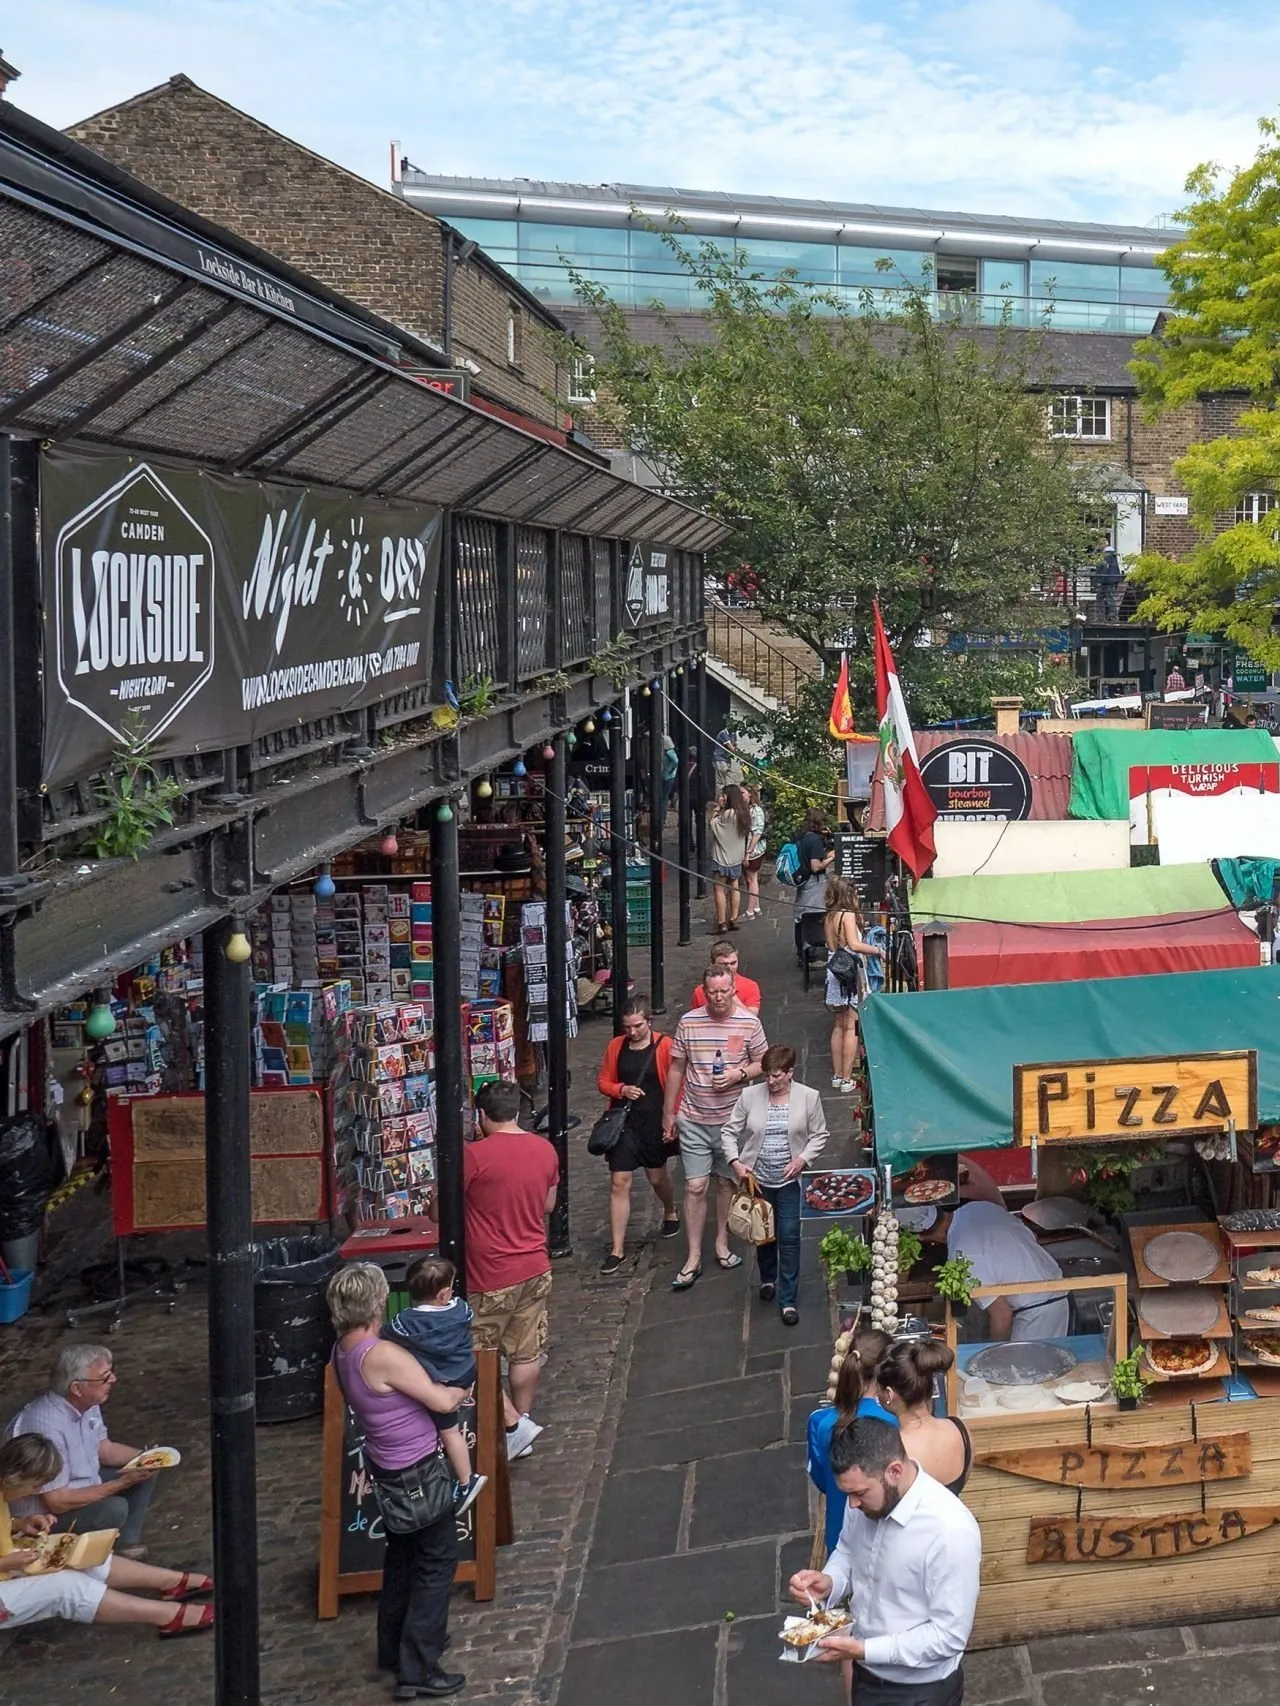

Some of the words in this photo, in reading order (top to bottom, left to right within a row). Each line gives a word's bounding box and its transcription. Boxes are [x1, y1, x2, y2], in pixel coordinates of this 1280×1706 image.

[198, 250, 240, 286] Lockside
[240, 270, 256, 294] Bar
[263, 282, 295, 312] Kitchen
[121, 521, 165, 541] CAMDEN
[243, 509, 334, 655] Night
[349, 541, 363, 599] &
[72, 547, 204, 676] LOCKSIDE
[1257, 719, 1279, 730] STICKY
[949, 752, 993, 783] BIT
[1171, 763, 1239, 775] DELICIOUS
[1181, 773, 1225, 784] TURKISH
[1190, 782, 1218, 791] WRAP
[948, 787, 991, 799] bourbon
[948, 797, 990, 810] steamed
[1059, 1443, 1226, 1481] PIZZA
[1041, 1510, 1247, 1559] RUSTICA
